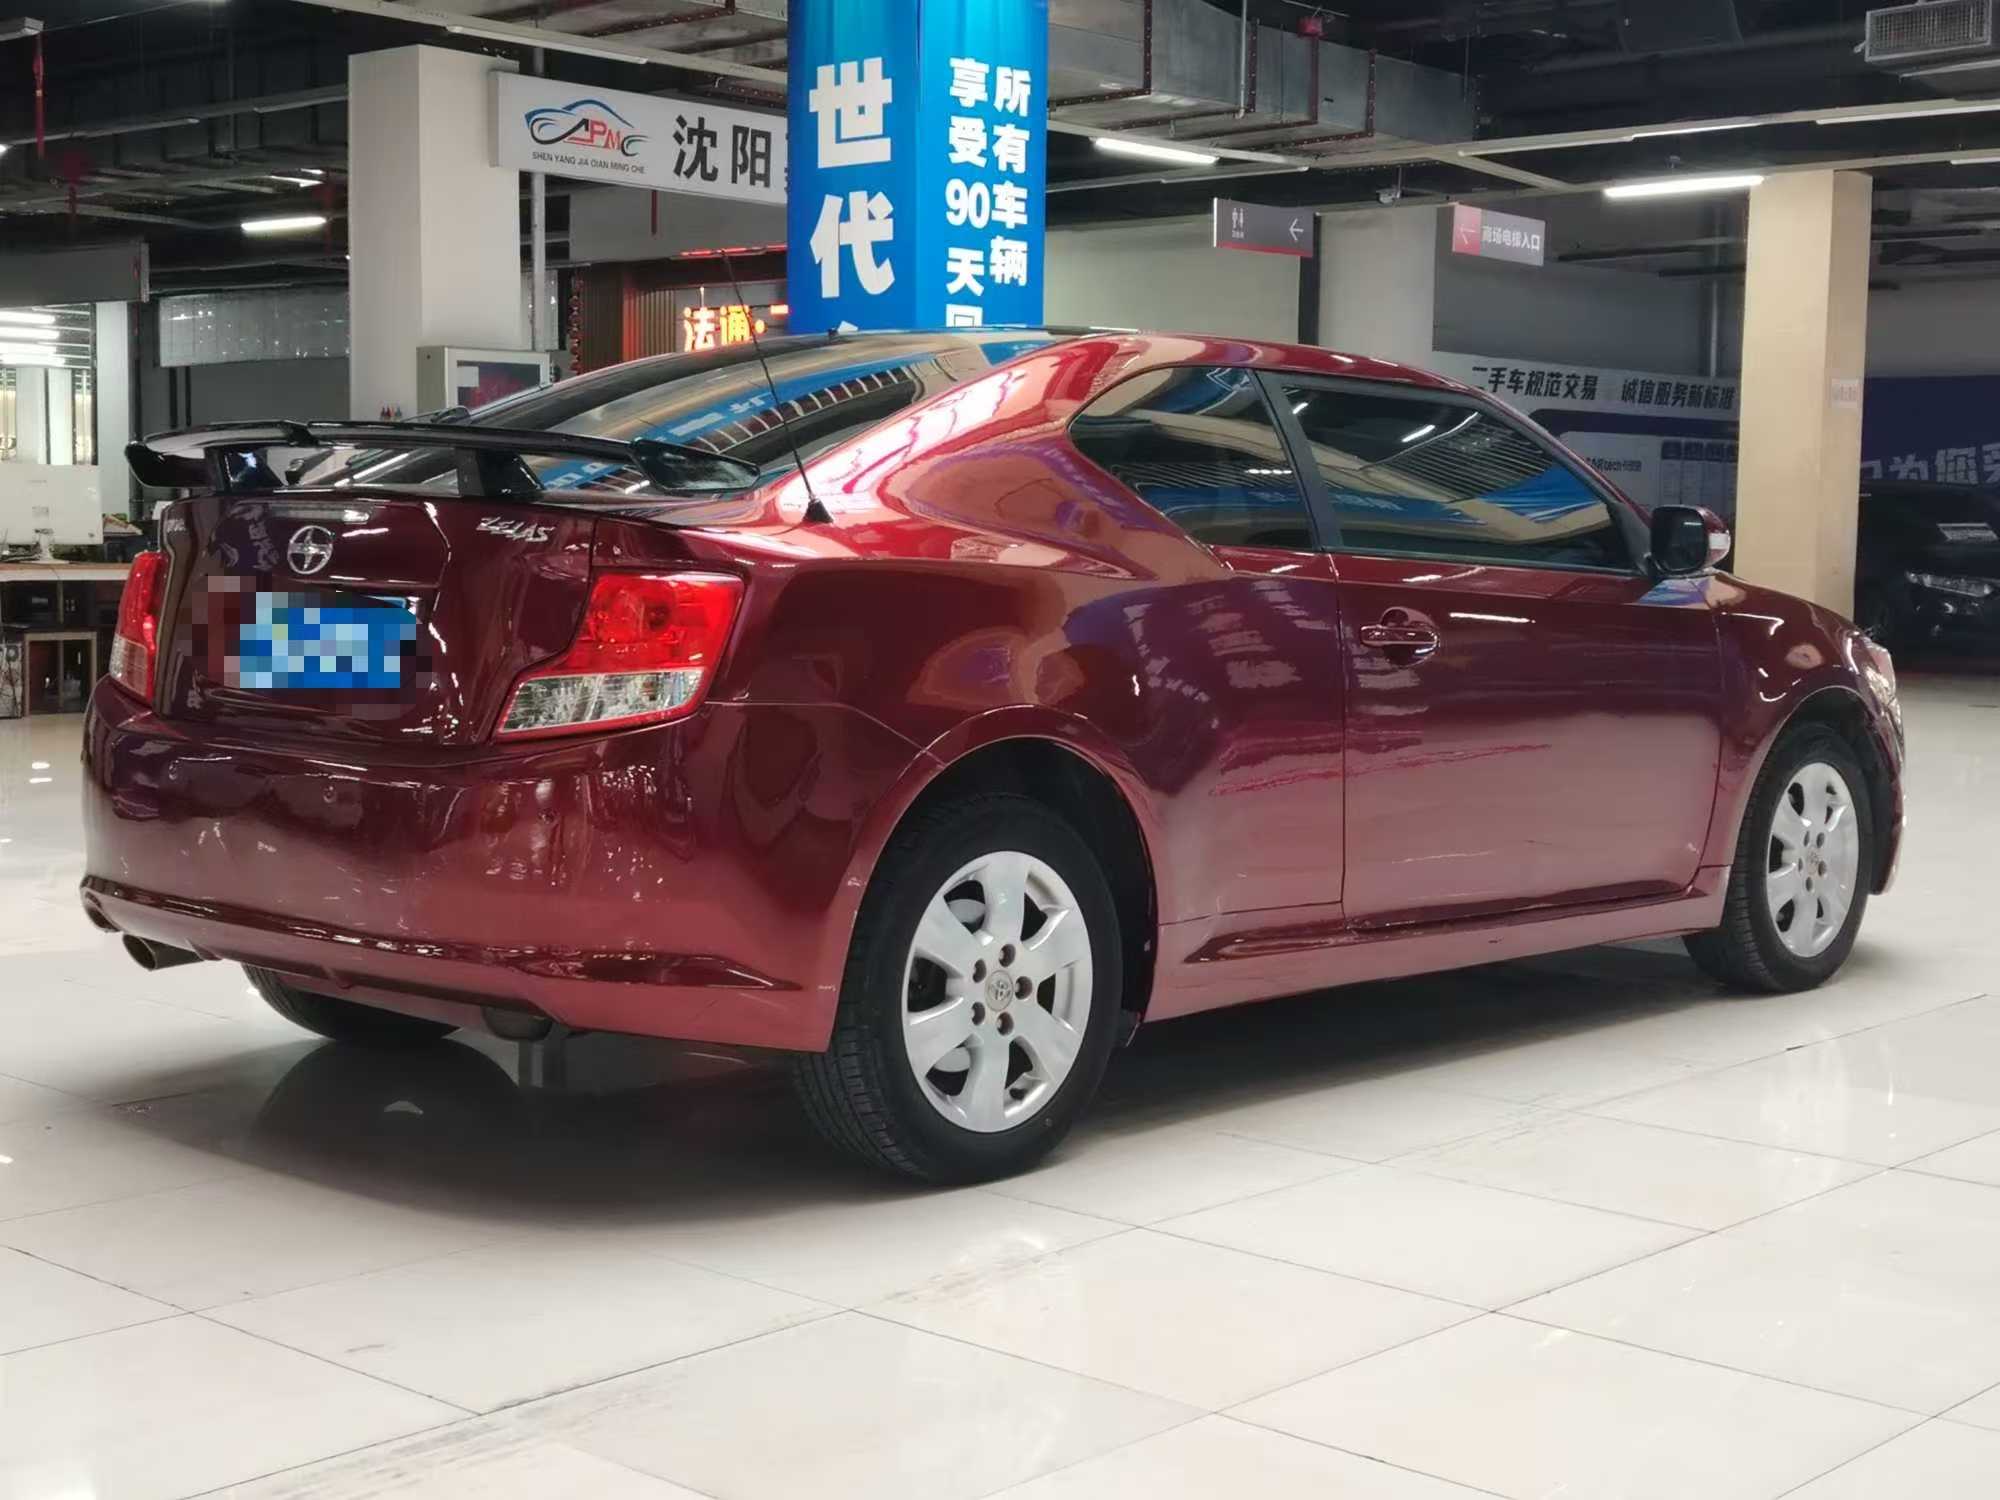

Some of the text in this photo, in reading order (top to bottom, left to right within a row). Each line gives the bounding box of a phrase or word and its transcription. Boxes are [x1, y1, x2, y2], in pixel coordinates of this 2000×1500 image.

[532, 151, 553, 162] SHEN
[554, 155, 576, 166] YANG
[577, 158, 589, 167] JIA
[610, 162, 630, 173] MING
[631, 165, 646, 175] CHE
[672, 114, 788, 196] 沈阳
[808, 57, 896, 331] 世代
[989, 66, 1031, 286] 所有车辆
